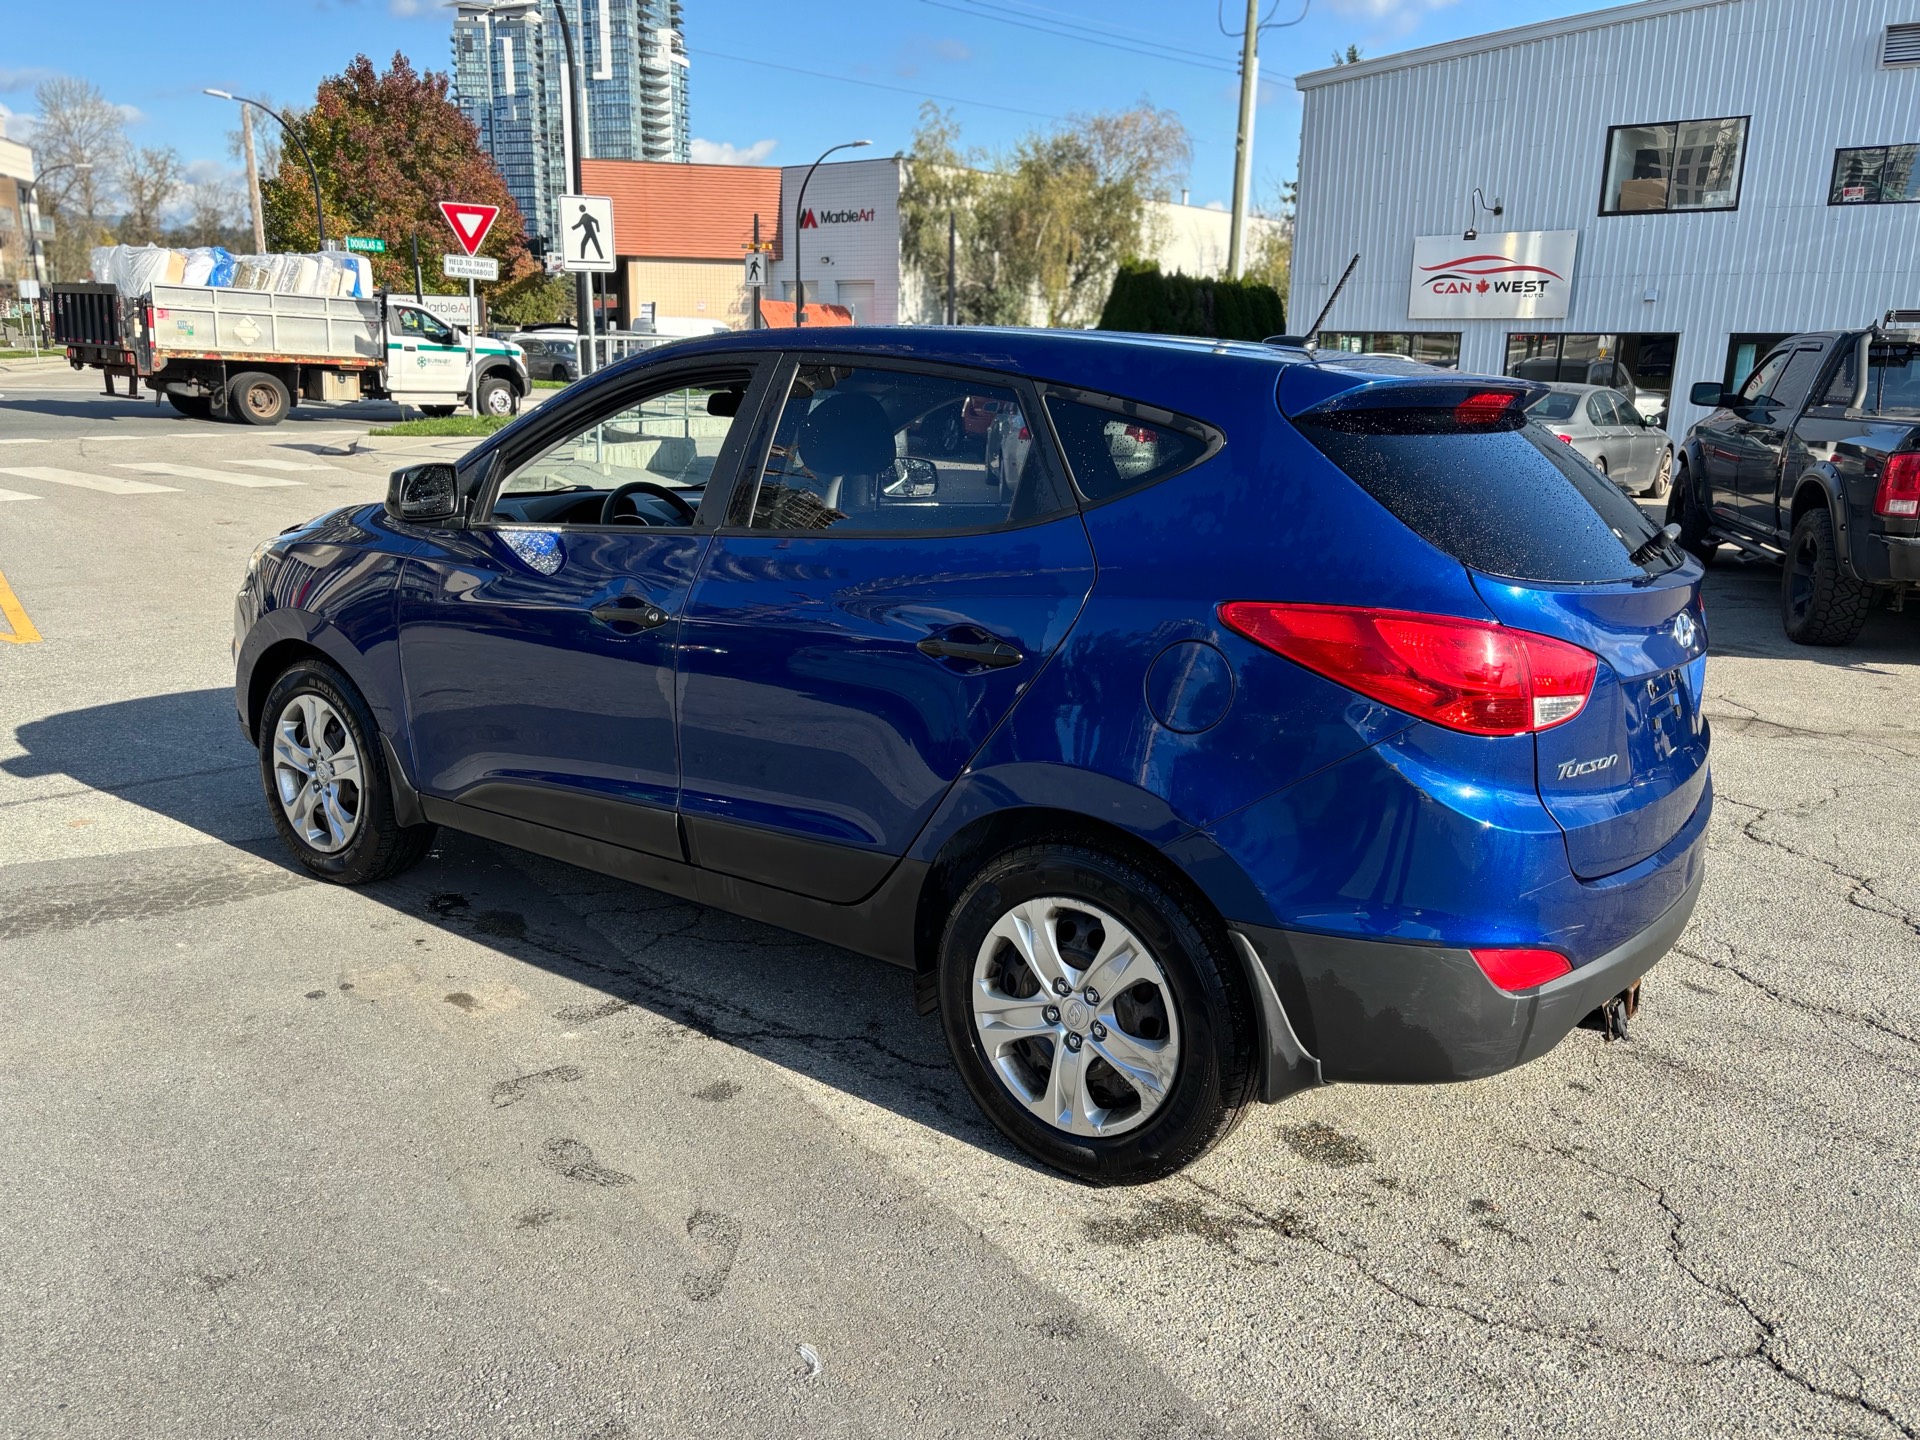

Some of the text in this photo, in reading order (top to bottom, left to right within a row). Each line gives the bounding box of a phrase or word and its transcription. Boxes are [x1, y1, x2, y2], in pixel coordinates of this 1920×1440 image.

[820, 208, 875, 224] MarbleArt
[350, 238, 376, 250] DOUGLAS
[448, 258, 494, 269] YIELD TO TRAFFIC
[457, 267, 494, 277] ROUNDABOUT
[1432, 280, 1550, 294] CAN WEST
[423, 302, 470, 314] arbleAr
[1557, 753, 1618, 781] Tucson
